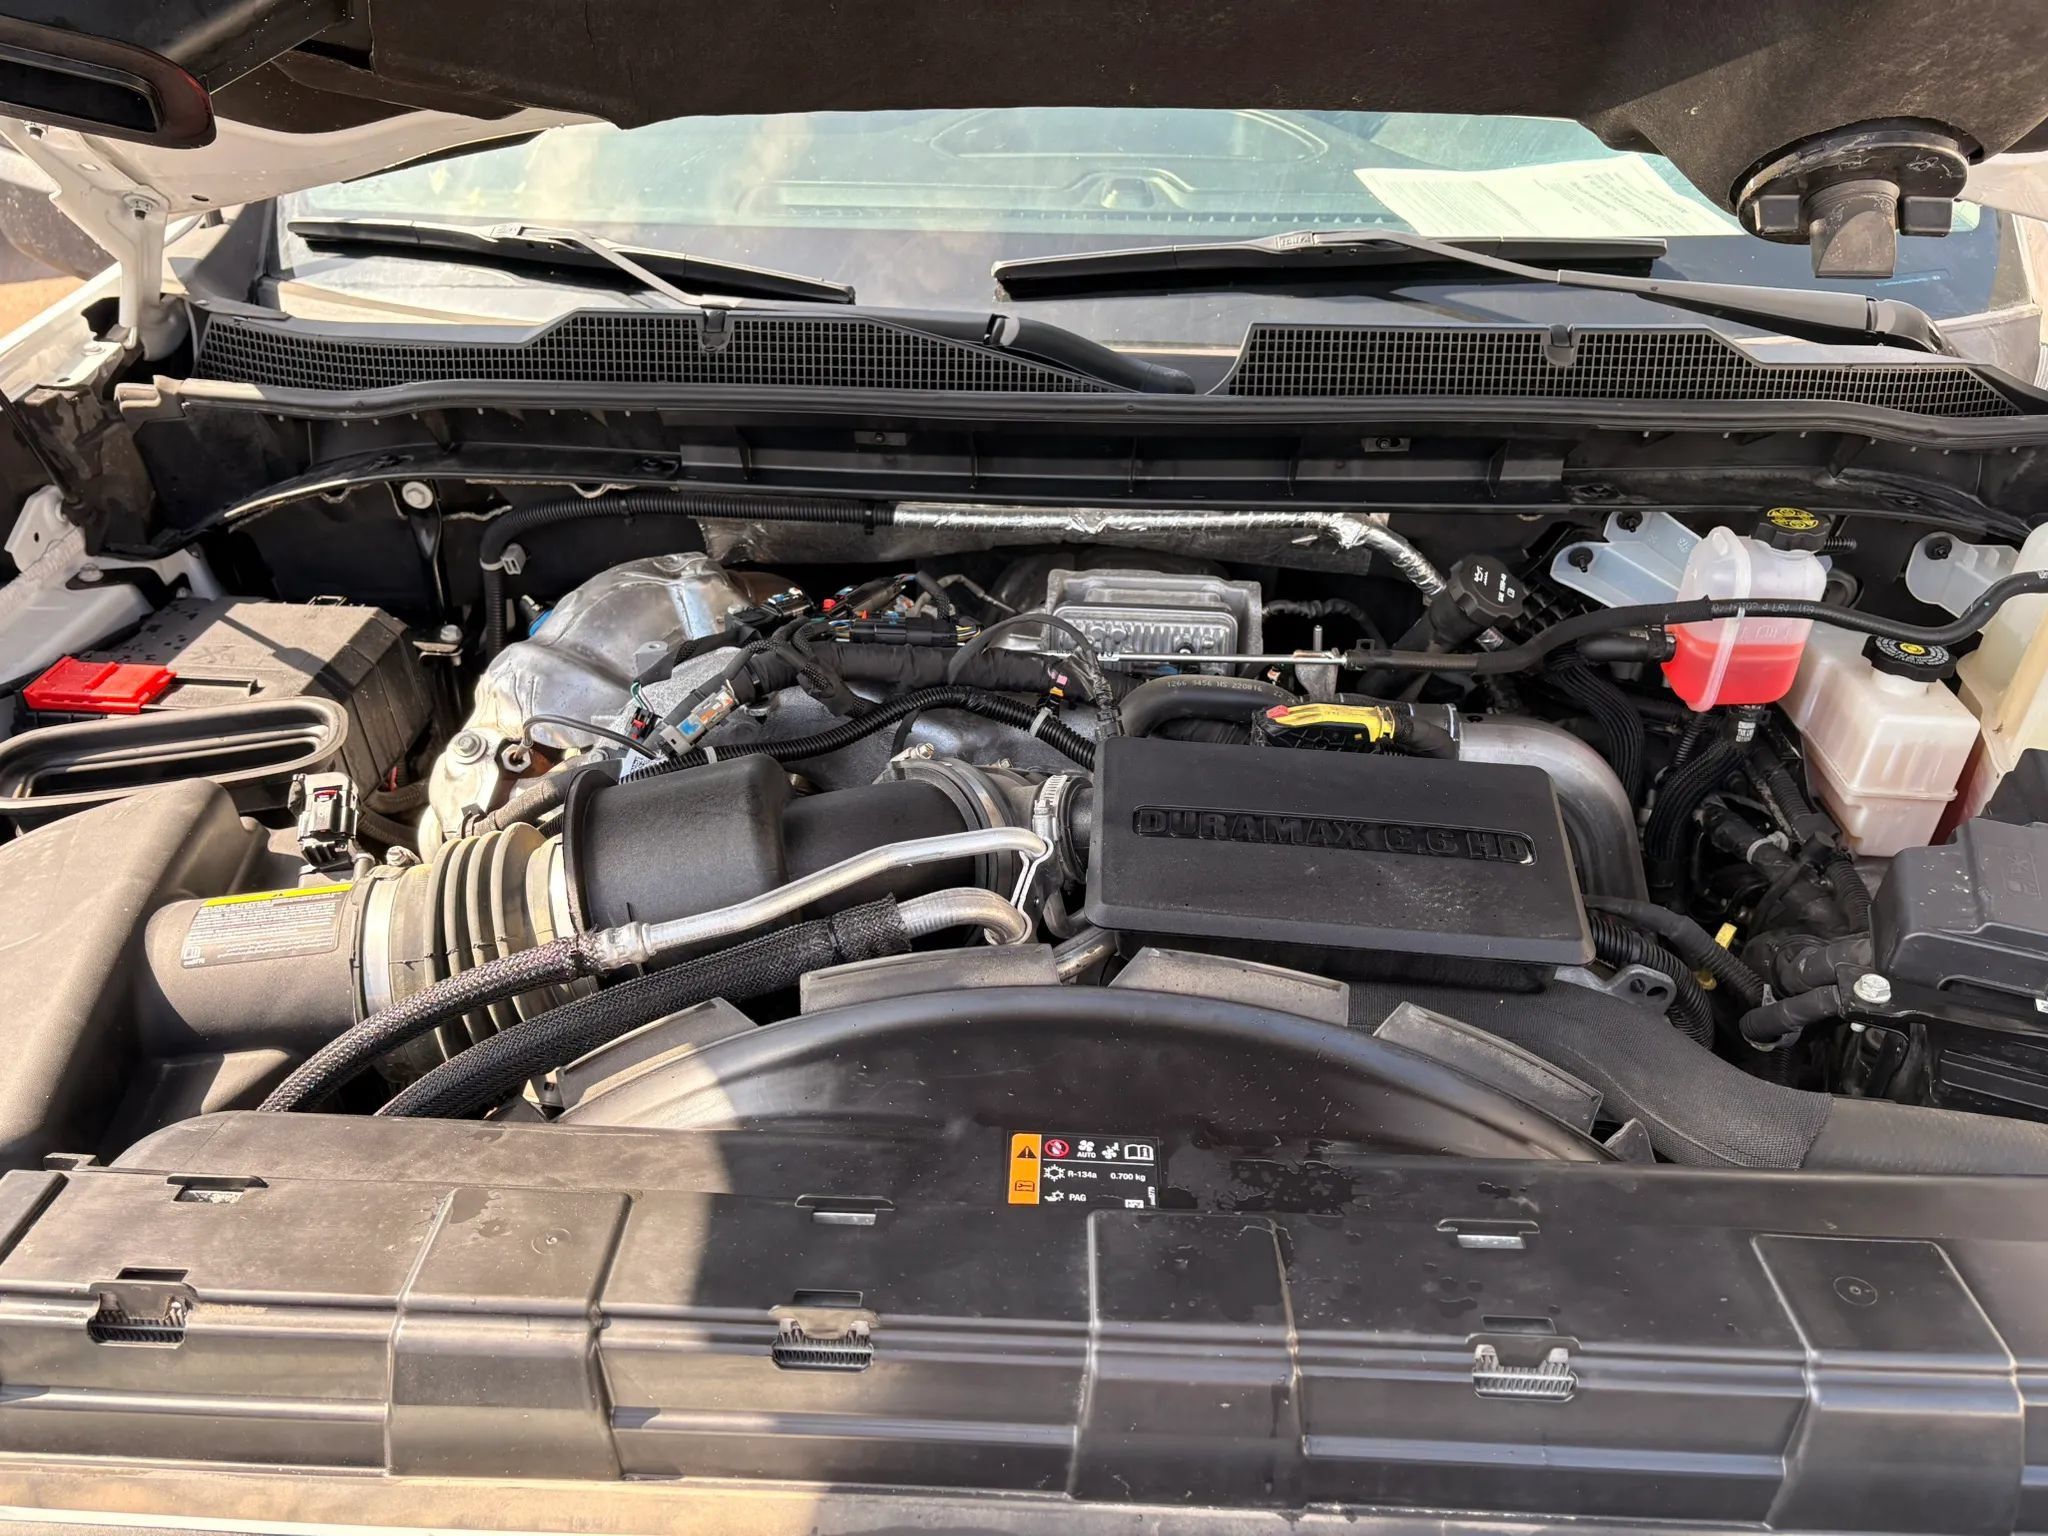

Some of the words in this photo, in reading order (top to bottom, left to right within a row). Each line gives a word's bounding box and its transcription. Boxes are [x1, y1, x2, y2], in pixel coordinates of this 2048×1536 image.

[1140, 809, 1366, 848] DURAMAX
[1384, 825, 1458, 854] 6.6
[1467, 831, 1533, 865] HD
[1067, 1170, 1098, 1179] R-134a
[1110, 1172, 1134, 1180] 0.700
[1135, 1174, 1146, 1183] kg
[1069, 1193, 1087, 1202] PAG
